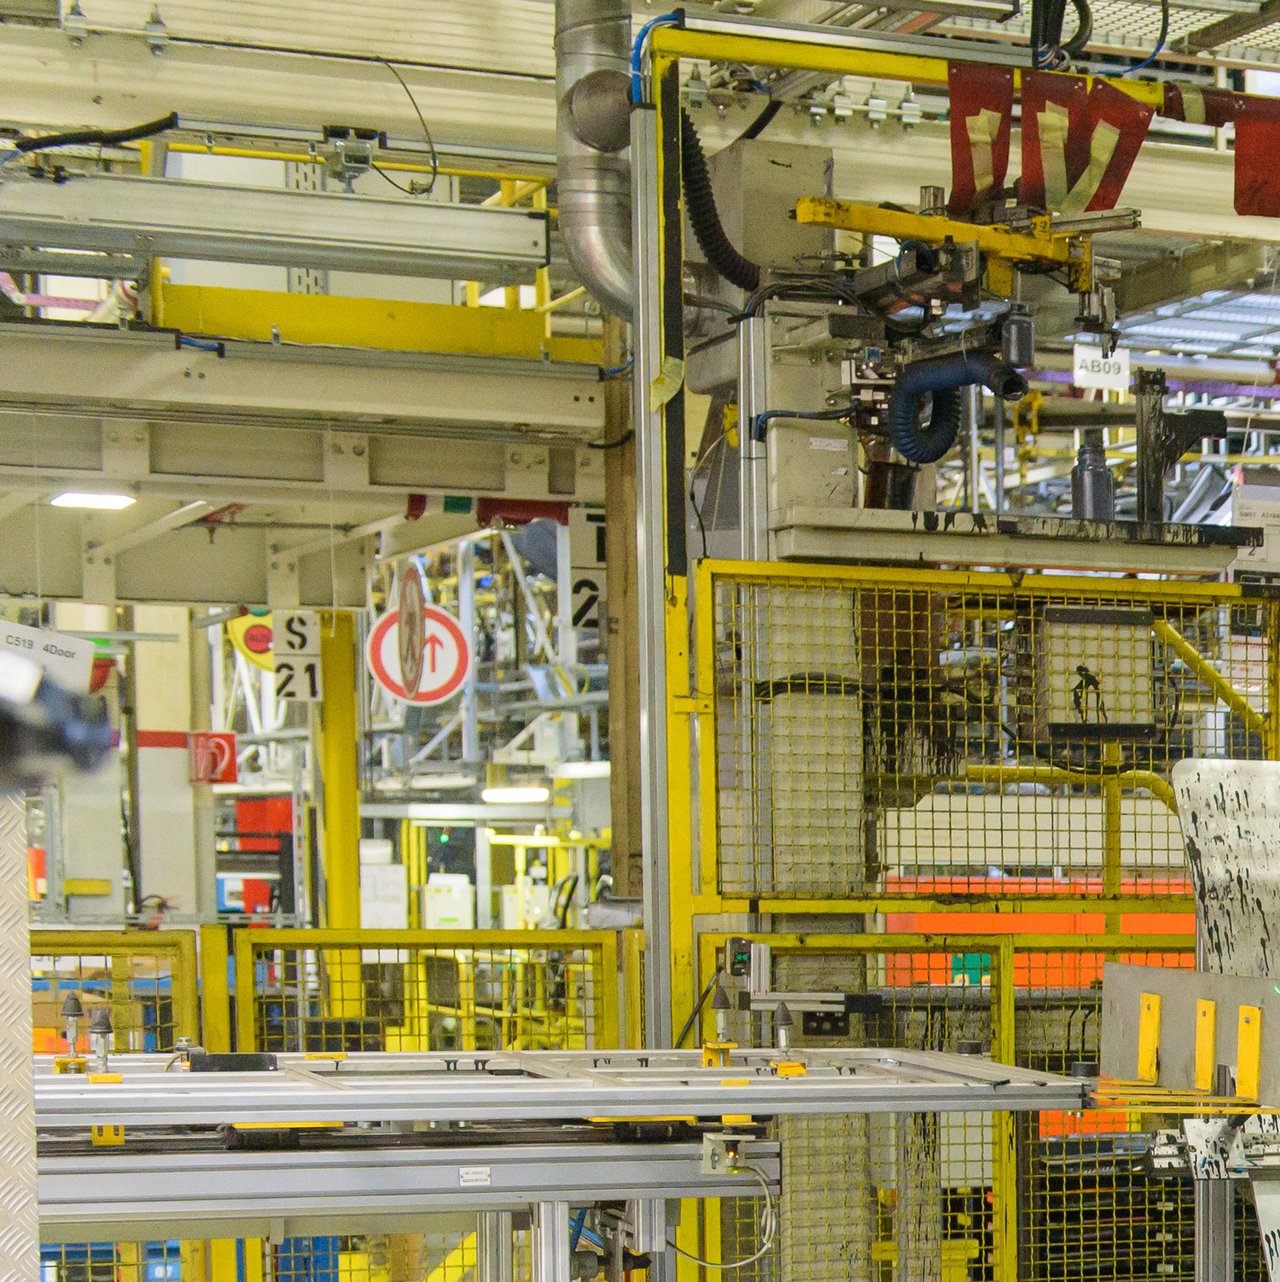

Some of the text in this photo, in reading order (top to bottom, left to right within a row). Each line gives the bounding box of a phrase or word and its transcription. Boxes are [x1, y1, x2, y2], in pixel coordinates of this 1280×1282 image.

[1080, 359, 1121, 375] AB09
[6, 635, 77, 659] C519 4Door
[286, 616, 307, 650] S
[275, 663, 318, 698] 21
